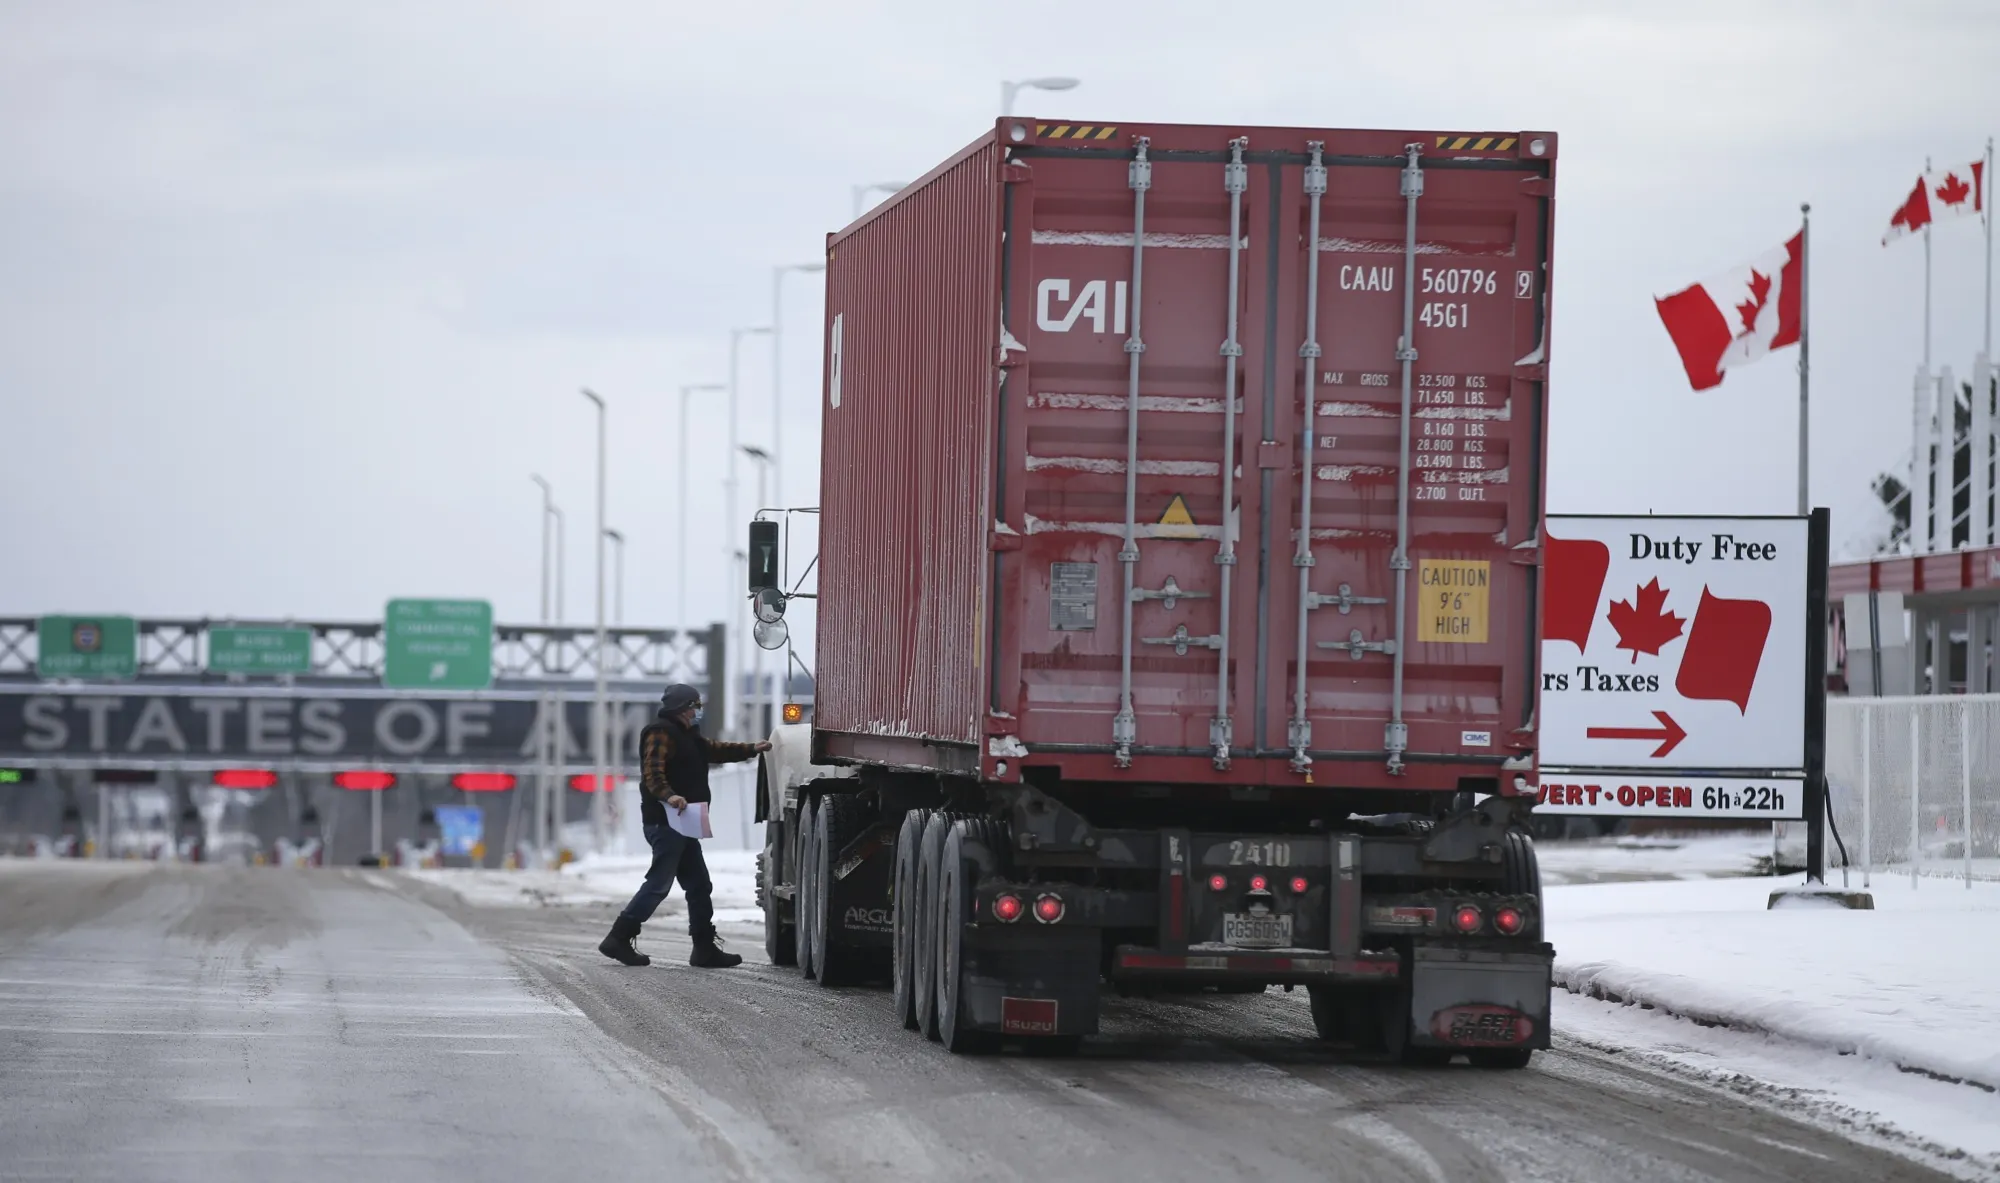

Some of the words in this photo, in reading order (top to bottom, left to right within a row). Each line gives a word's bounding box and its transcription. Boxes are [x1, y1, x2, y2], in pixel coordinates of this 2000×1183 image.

[1340, 265, 1394, 291] CAAU
[1422, 268, 1497, 294] 560796
[1519, 272, 1530, 296] 9
[1036, 279, 1127, 334] CAI
[1419, 303, 1468, 328] 45G1
[1323, 372, 1343, 384] MAX
[1360, 374, 1389, 387] GROSS
[1419, 374, 1456, 387] 32.500
[1465, 375, 1488, 388] KGS.
[1418, 390, 1454, 404] 71.650
[1464, 391, 1487, 405] LBS.
[1423, 422, 1455, 436] 8.160
[1464, 423, 1487, 437] LBS.
[1320, 436, 1338, 449] NET
[1416, 439, 1454, 451] 28.800
[1463, 440, 1486, 453] KGS.
[1415, 454, 1453, 468] 63.490
[1462, 455, 1486, 469] LBS.
[1416, 486, 1446, 500] 2.700
[1629, 533, 1703, 564] Duty
[1711, 534, 1777, 561] Free
[1422, 567, 1487, 587] CAUTION
[1436, 616, 1470, 635] HIGH
[1542, 673, 1569, 692] rs
[1576, 666, 1660, 692] Taxes
[22, 698, 347, 755] STATES
[375, 699, 495, 756] OF
[1617, 785, 1692, 808] OPEN
[1229, 840, 1290, 867] 2410
[1005, 1019, 1052, 1032] ISUZU
